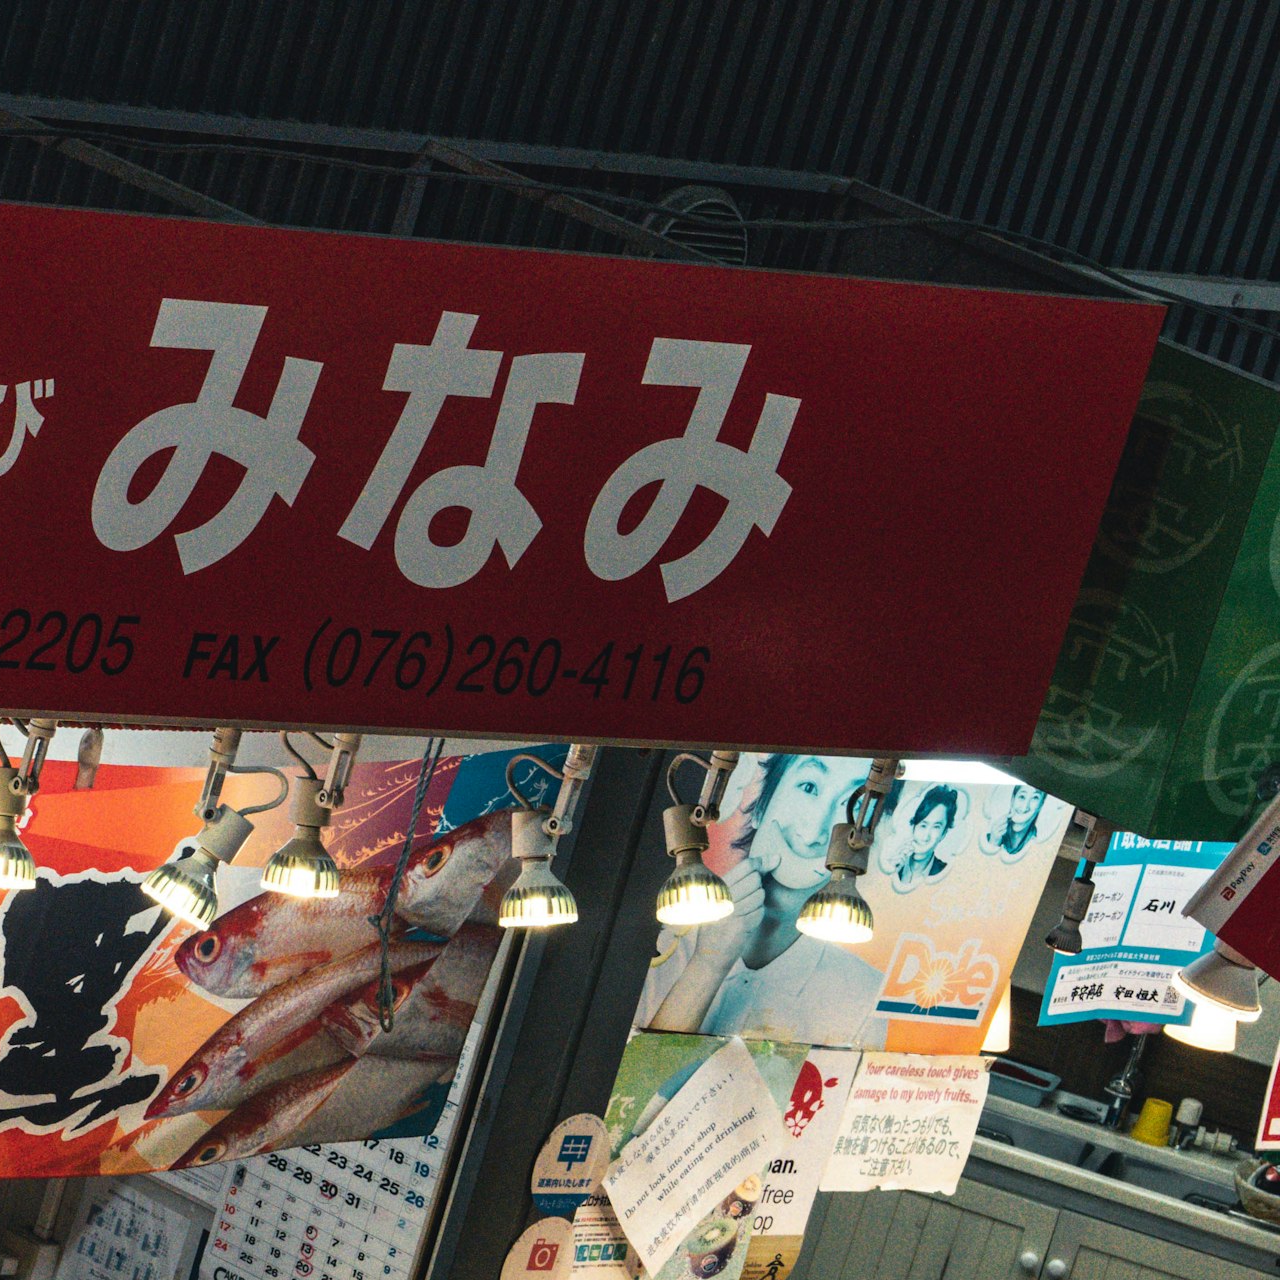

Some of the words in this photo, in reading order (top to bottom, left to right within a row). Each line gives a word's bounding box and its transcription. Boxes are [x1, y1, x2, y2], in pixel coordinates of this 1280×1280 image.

[89, 296, 801, 605] みなみ
[182, 630, 281, 686] FAX
[300, 623, 711, 713] (076)260-4116
[1231, 861, 1256, 890] PayPay
[1143, 899, 1175, 914] 石川
[883, 937, 992, 1008] Dole
[854, 1088, 887, 1103] damage
[891, 1088, 899, 1100] to
[900, 1090, 913, 1104] my
[915, 1088, 941, 1104] lovely
[866, 1062, 884, 1075] Your
[885, 1064, 926, 1078] careless
[927, 1066, 952, 1079] touch
[952, 1066, 979, 1081] gives
[328, 1152, 346, 1168] 23
[354, 1165, 372, 1182] 24
[380, 1179, 399, 1195] 25
[405, 1191, 424, 1208] 26
[389, 1149, 404, 1163] 18
[414, 1161, 430, 1177] 19
[624, 1205, 637, 1219] Do
[636, 1193, 649, 1208] not
[649, 1173, 666, 1192] look
[667, 1155, 683, 1174] into
[683, 1143, 696, 1158] my
[696, 1121, 717, 1143] shop
[657, 1178, 679, 1202] while
[679, 1152, 706, 1181] eating
[705, 1142, 715, 1155] or
[714, 1106, 758, 1145] drinking!
[268, 1155, 287, 1171] 28
[293, 1167, 312, 1184] 29
[320, 1180, 338, 1197] 30
[344, 1193, 362, 1208] 31
[353, 1270, 363, 1280] 15
